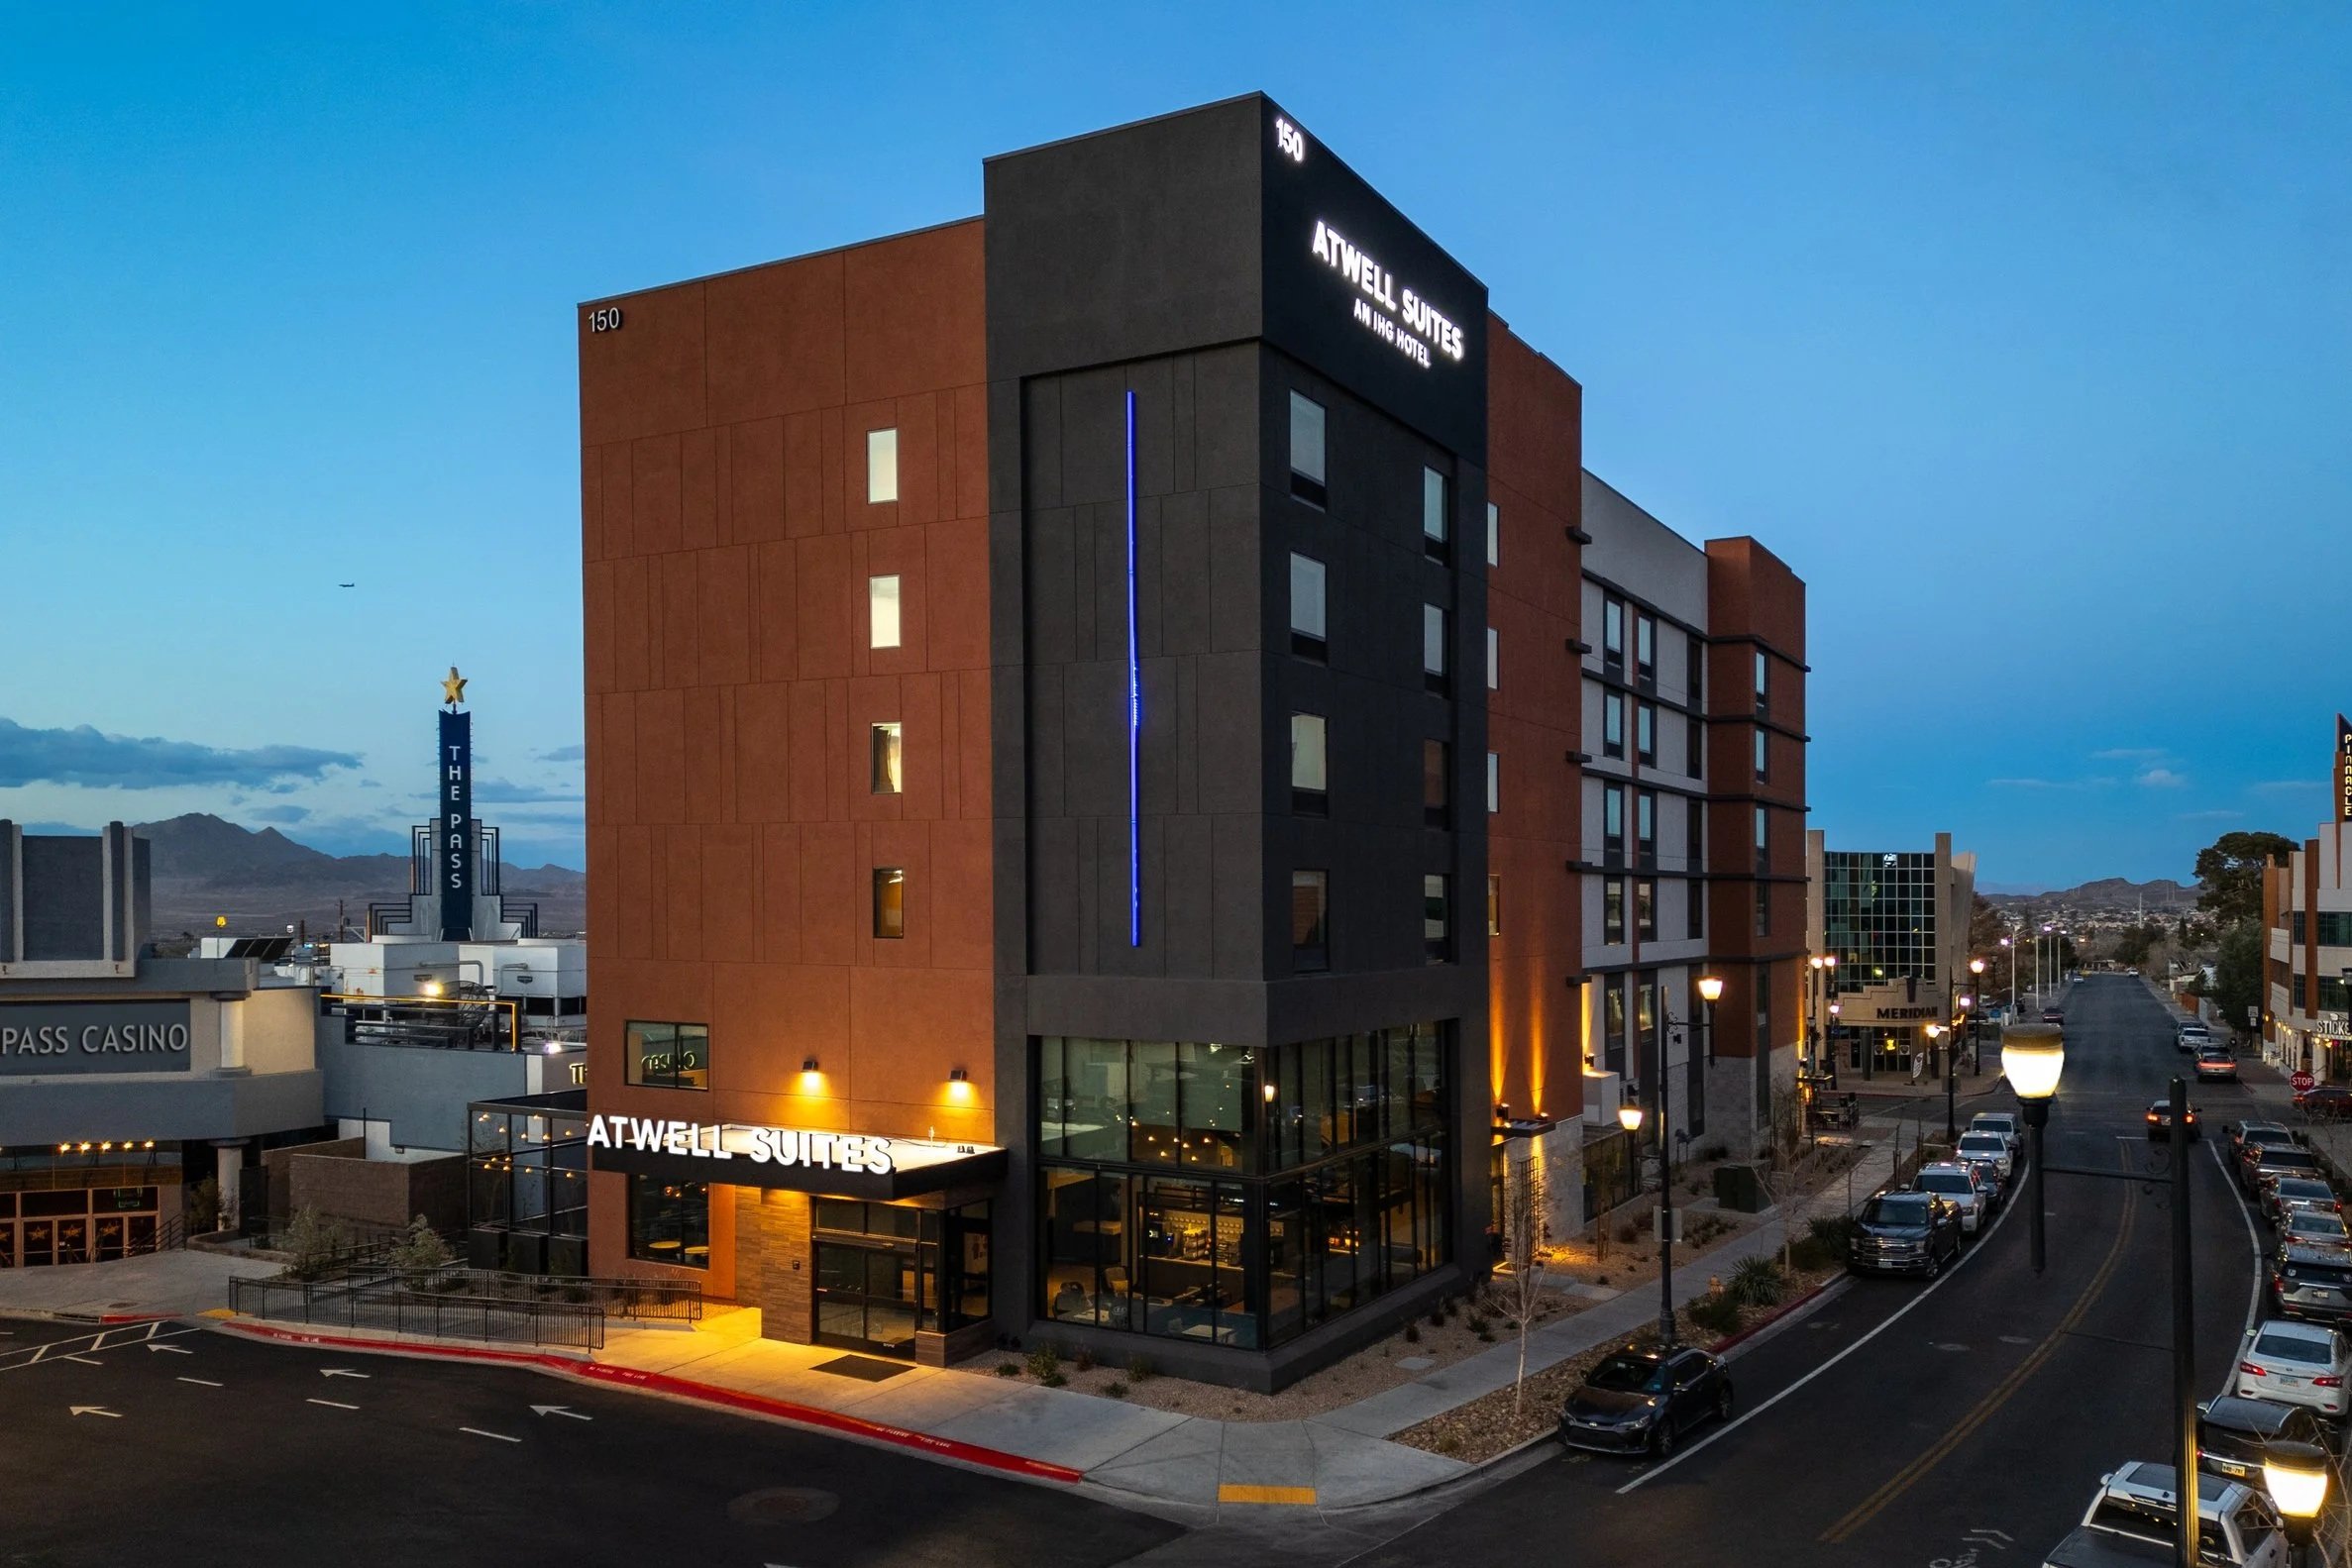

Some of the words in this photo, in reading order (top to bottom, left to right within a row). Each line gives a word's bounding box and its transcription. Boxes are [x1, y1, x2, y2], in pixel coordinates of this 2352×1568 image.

[1276, 118, 1304, 161] 150
[1312, 221, 1397, 312] ATWELL
[1402, 288, 1464, 361] SUITES
[588, 307, 620, 333] 150
[1353, 298, 1371, 328] AN
[1373, 310, 1395, 343] IHG
[1396, 327, 1432, 369] HOTEL
[448, 745, 462, 801] THE
[450, 813, 463, 889] PASS
[1876, 1005, 1939, 1020] MERIDIAN
[1, 1025, 69, 1056] PASS
[81, 1023, 189, 1054] CASINO
[2292, 1076, 2314, 1087] STOP
[587, 1113, 733, 1160] ATWELL
[749, 1127, 893, 1176] SUITES
